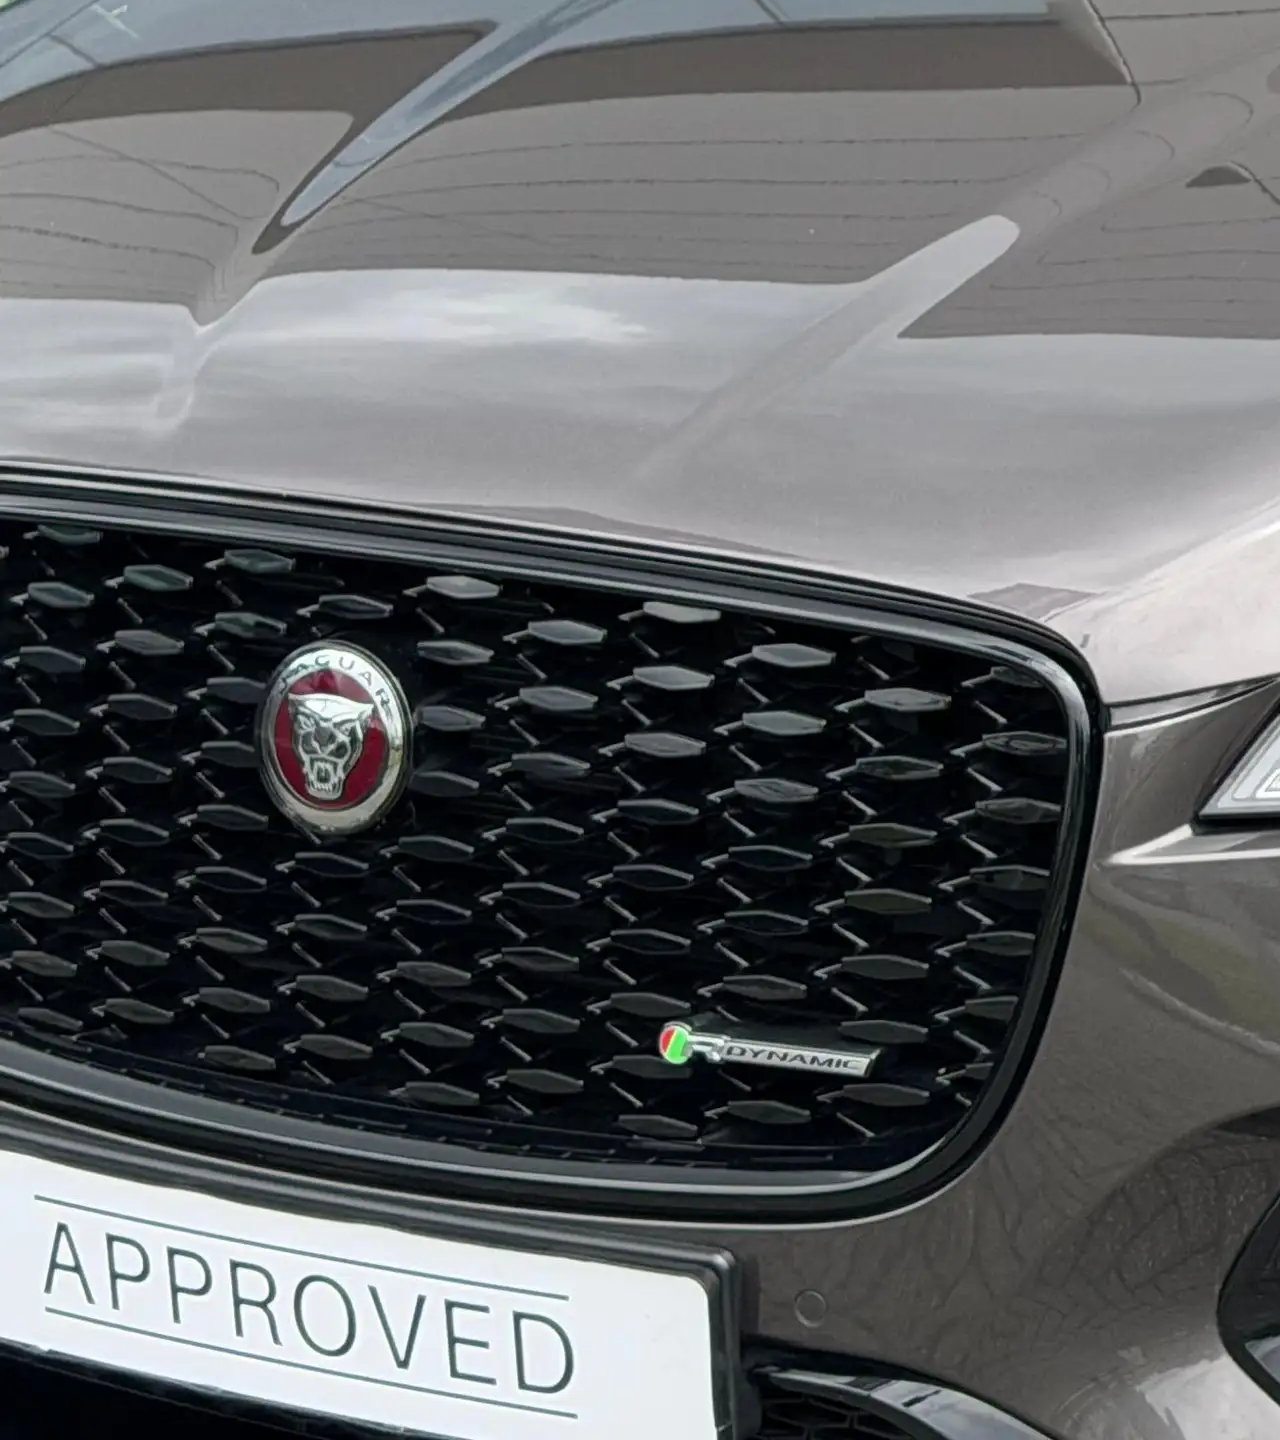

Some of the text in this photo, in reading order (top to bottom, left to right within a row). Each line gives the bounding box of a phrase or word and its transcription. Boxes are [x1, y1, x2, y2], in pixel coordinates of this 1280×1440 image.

[280, 654, 394, 722] JAGUAR
[726, 1045, 863, 1071] DYNAMIC
[43, 1221, 574, 1395] APPROVED
